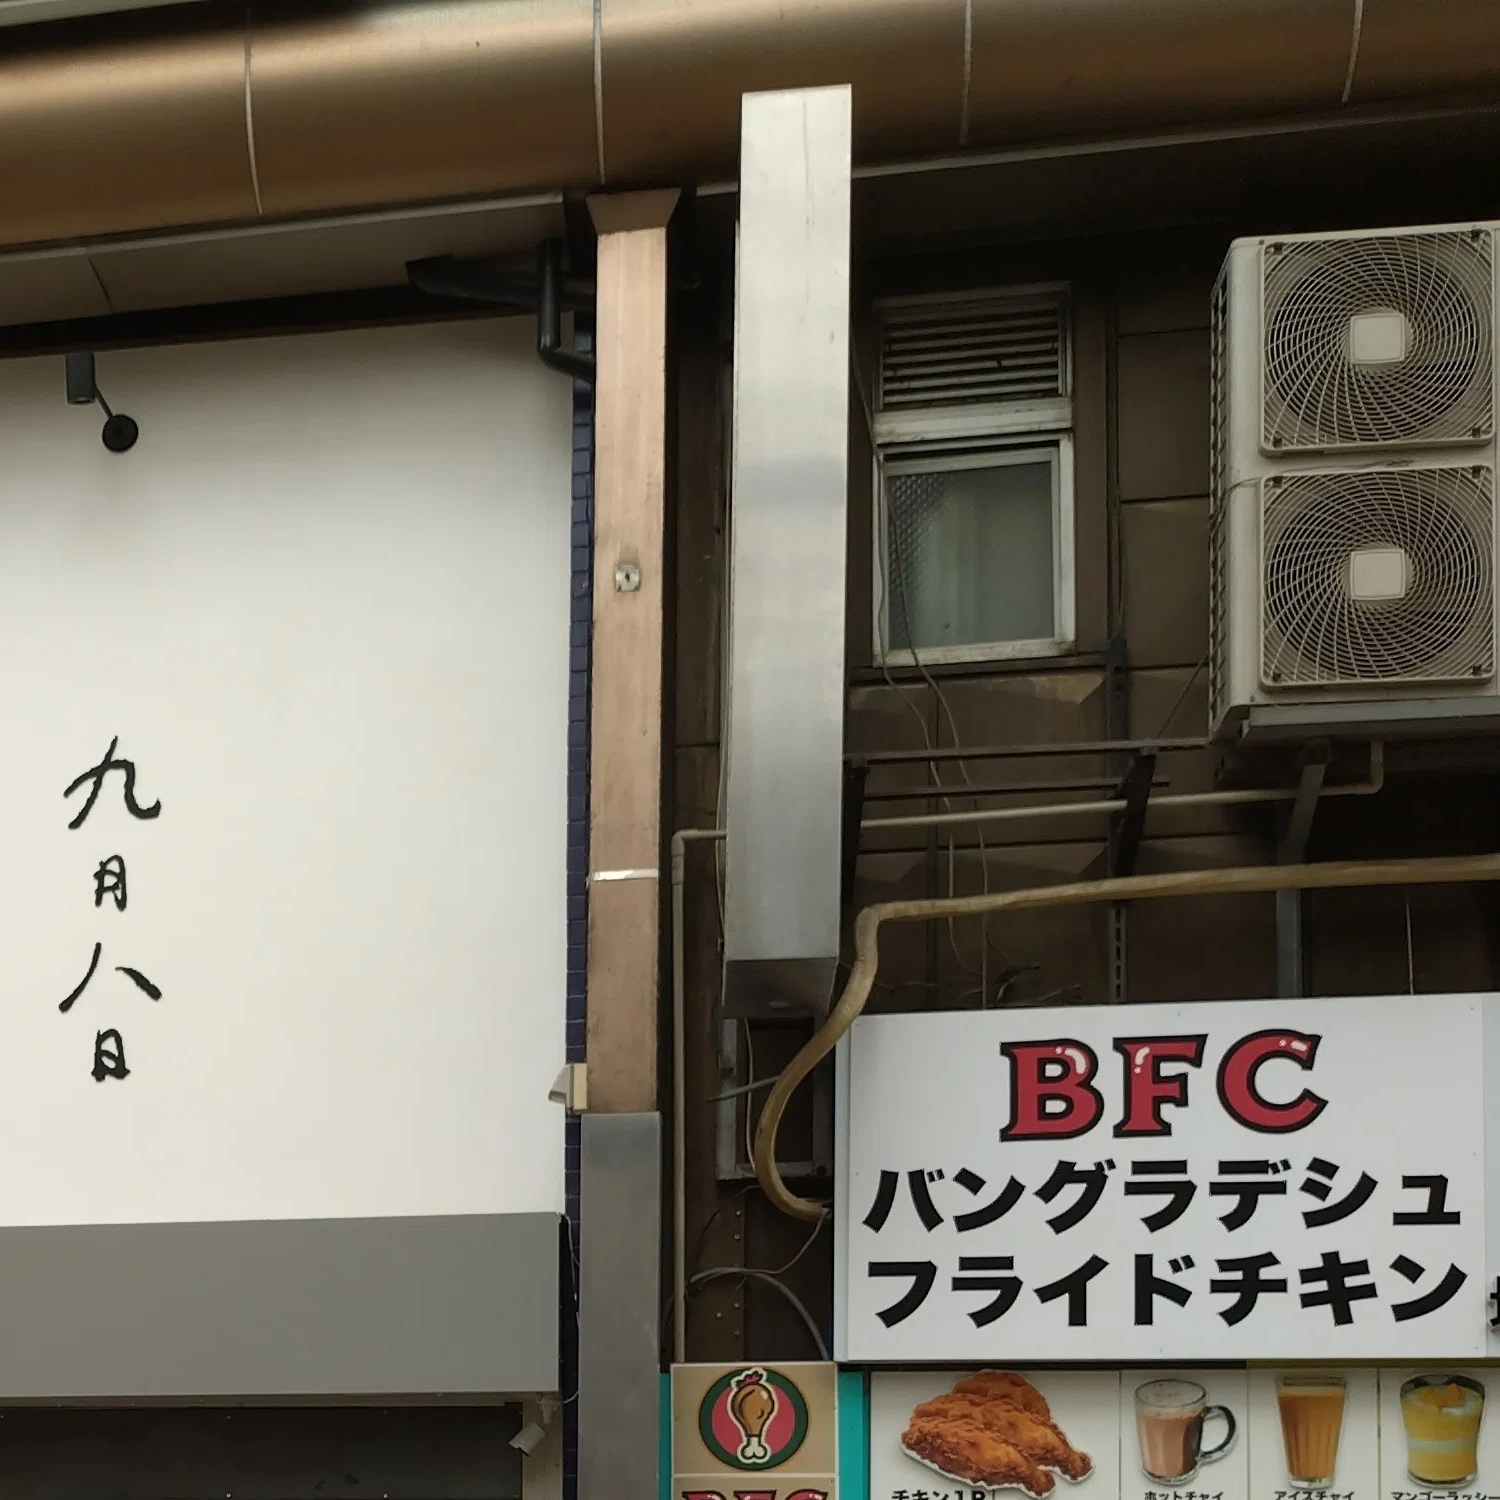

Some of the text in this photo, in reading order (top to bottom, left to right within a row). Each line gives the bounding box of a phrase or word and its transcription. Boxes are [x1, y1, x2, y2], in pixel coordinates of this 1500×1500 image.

[58, 735, 162, 1083] 九月八日
[999, 1029, 1329, 1142] BFC
[862, 1157, 1461, 1234] バングラデシュ
[868, 1251, 1468, 1329] フライドチキン
